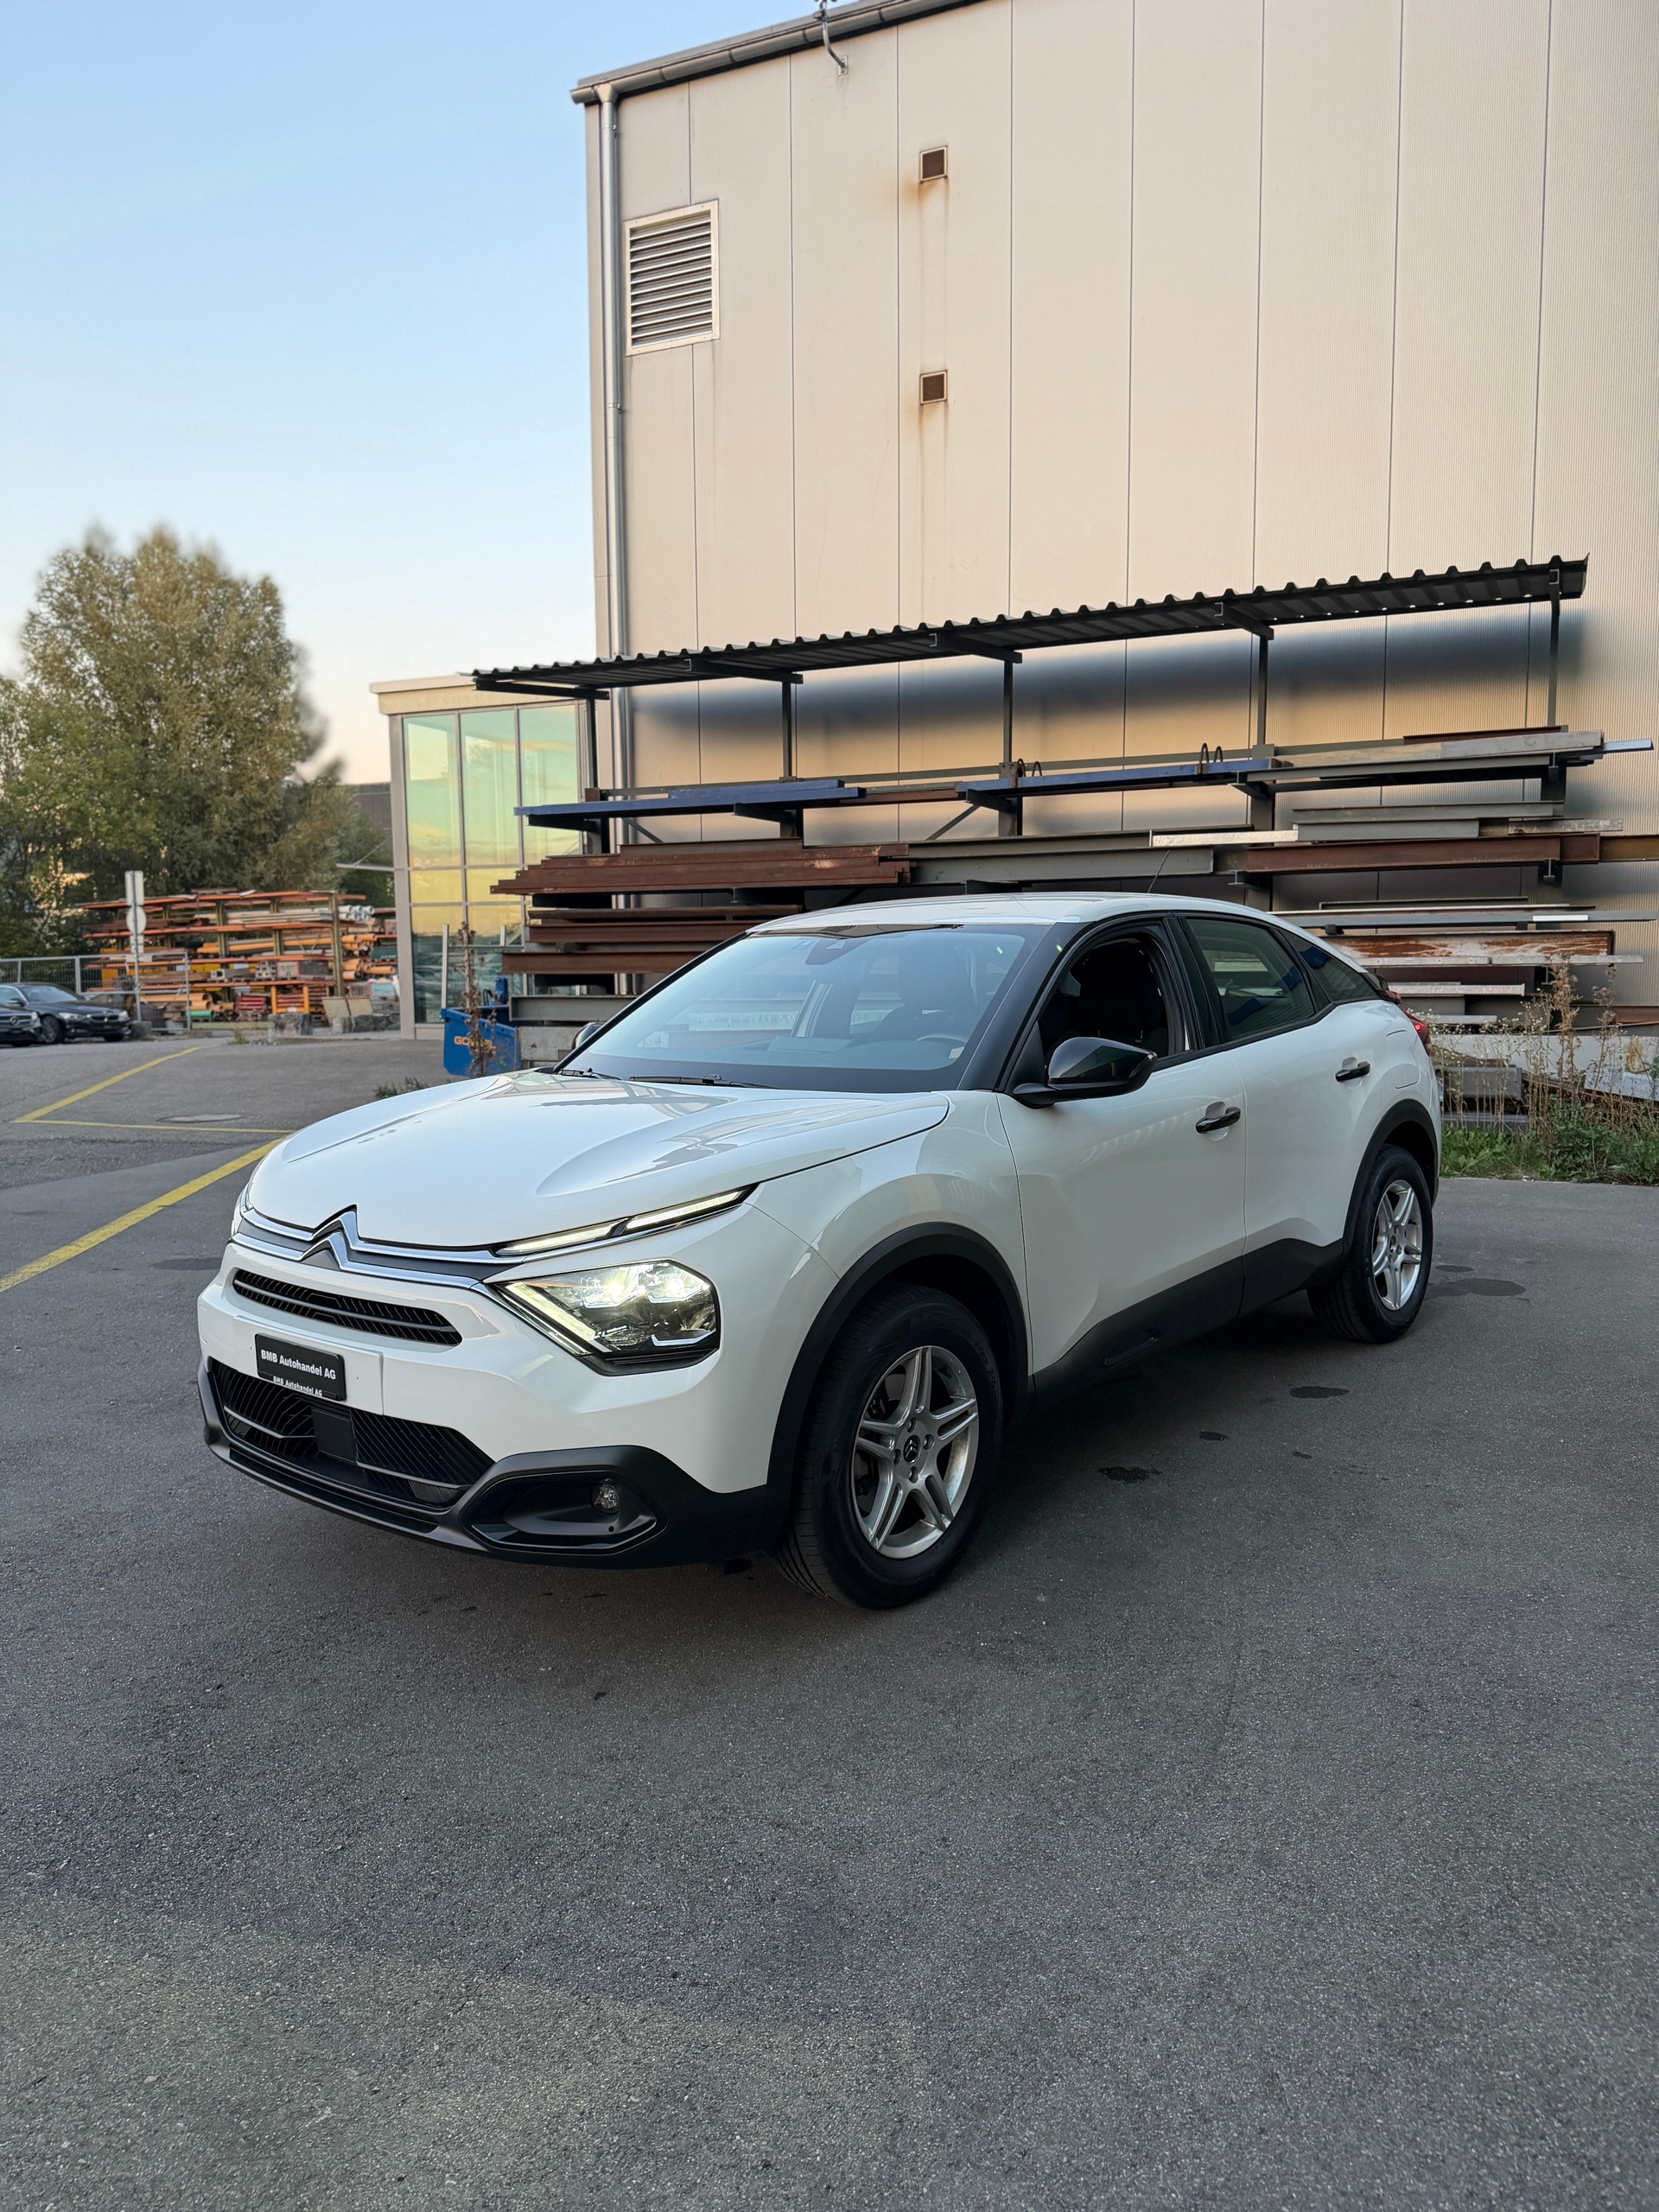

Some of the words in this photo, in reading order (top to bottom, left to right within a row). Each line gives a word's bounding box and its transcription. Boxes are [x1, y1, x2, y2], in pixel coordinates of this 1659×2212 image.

[261, 1349, 277, 1363] BMB
[279, 1355, 322, 1376] Autohandel
[324, 1368, 336, 1380] AG
[273, 1376, 284, 1385] BMB
[285, 1380, 314, 1394] Autohandel
